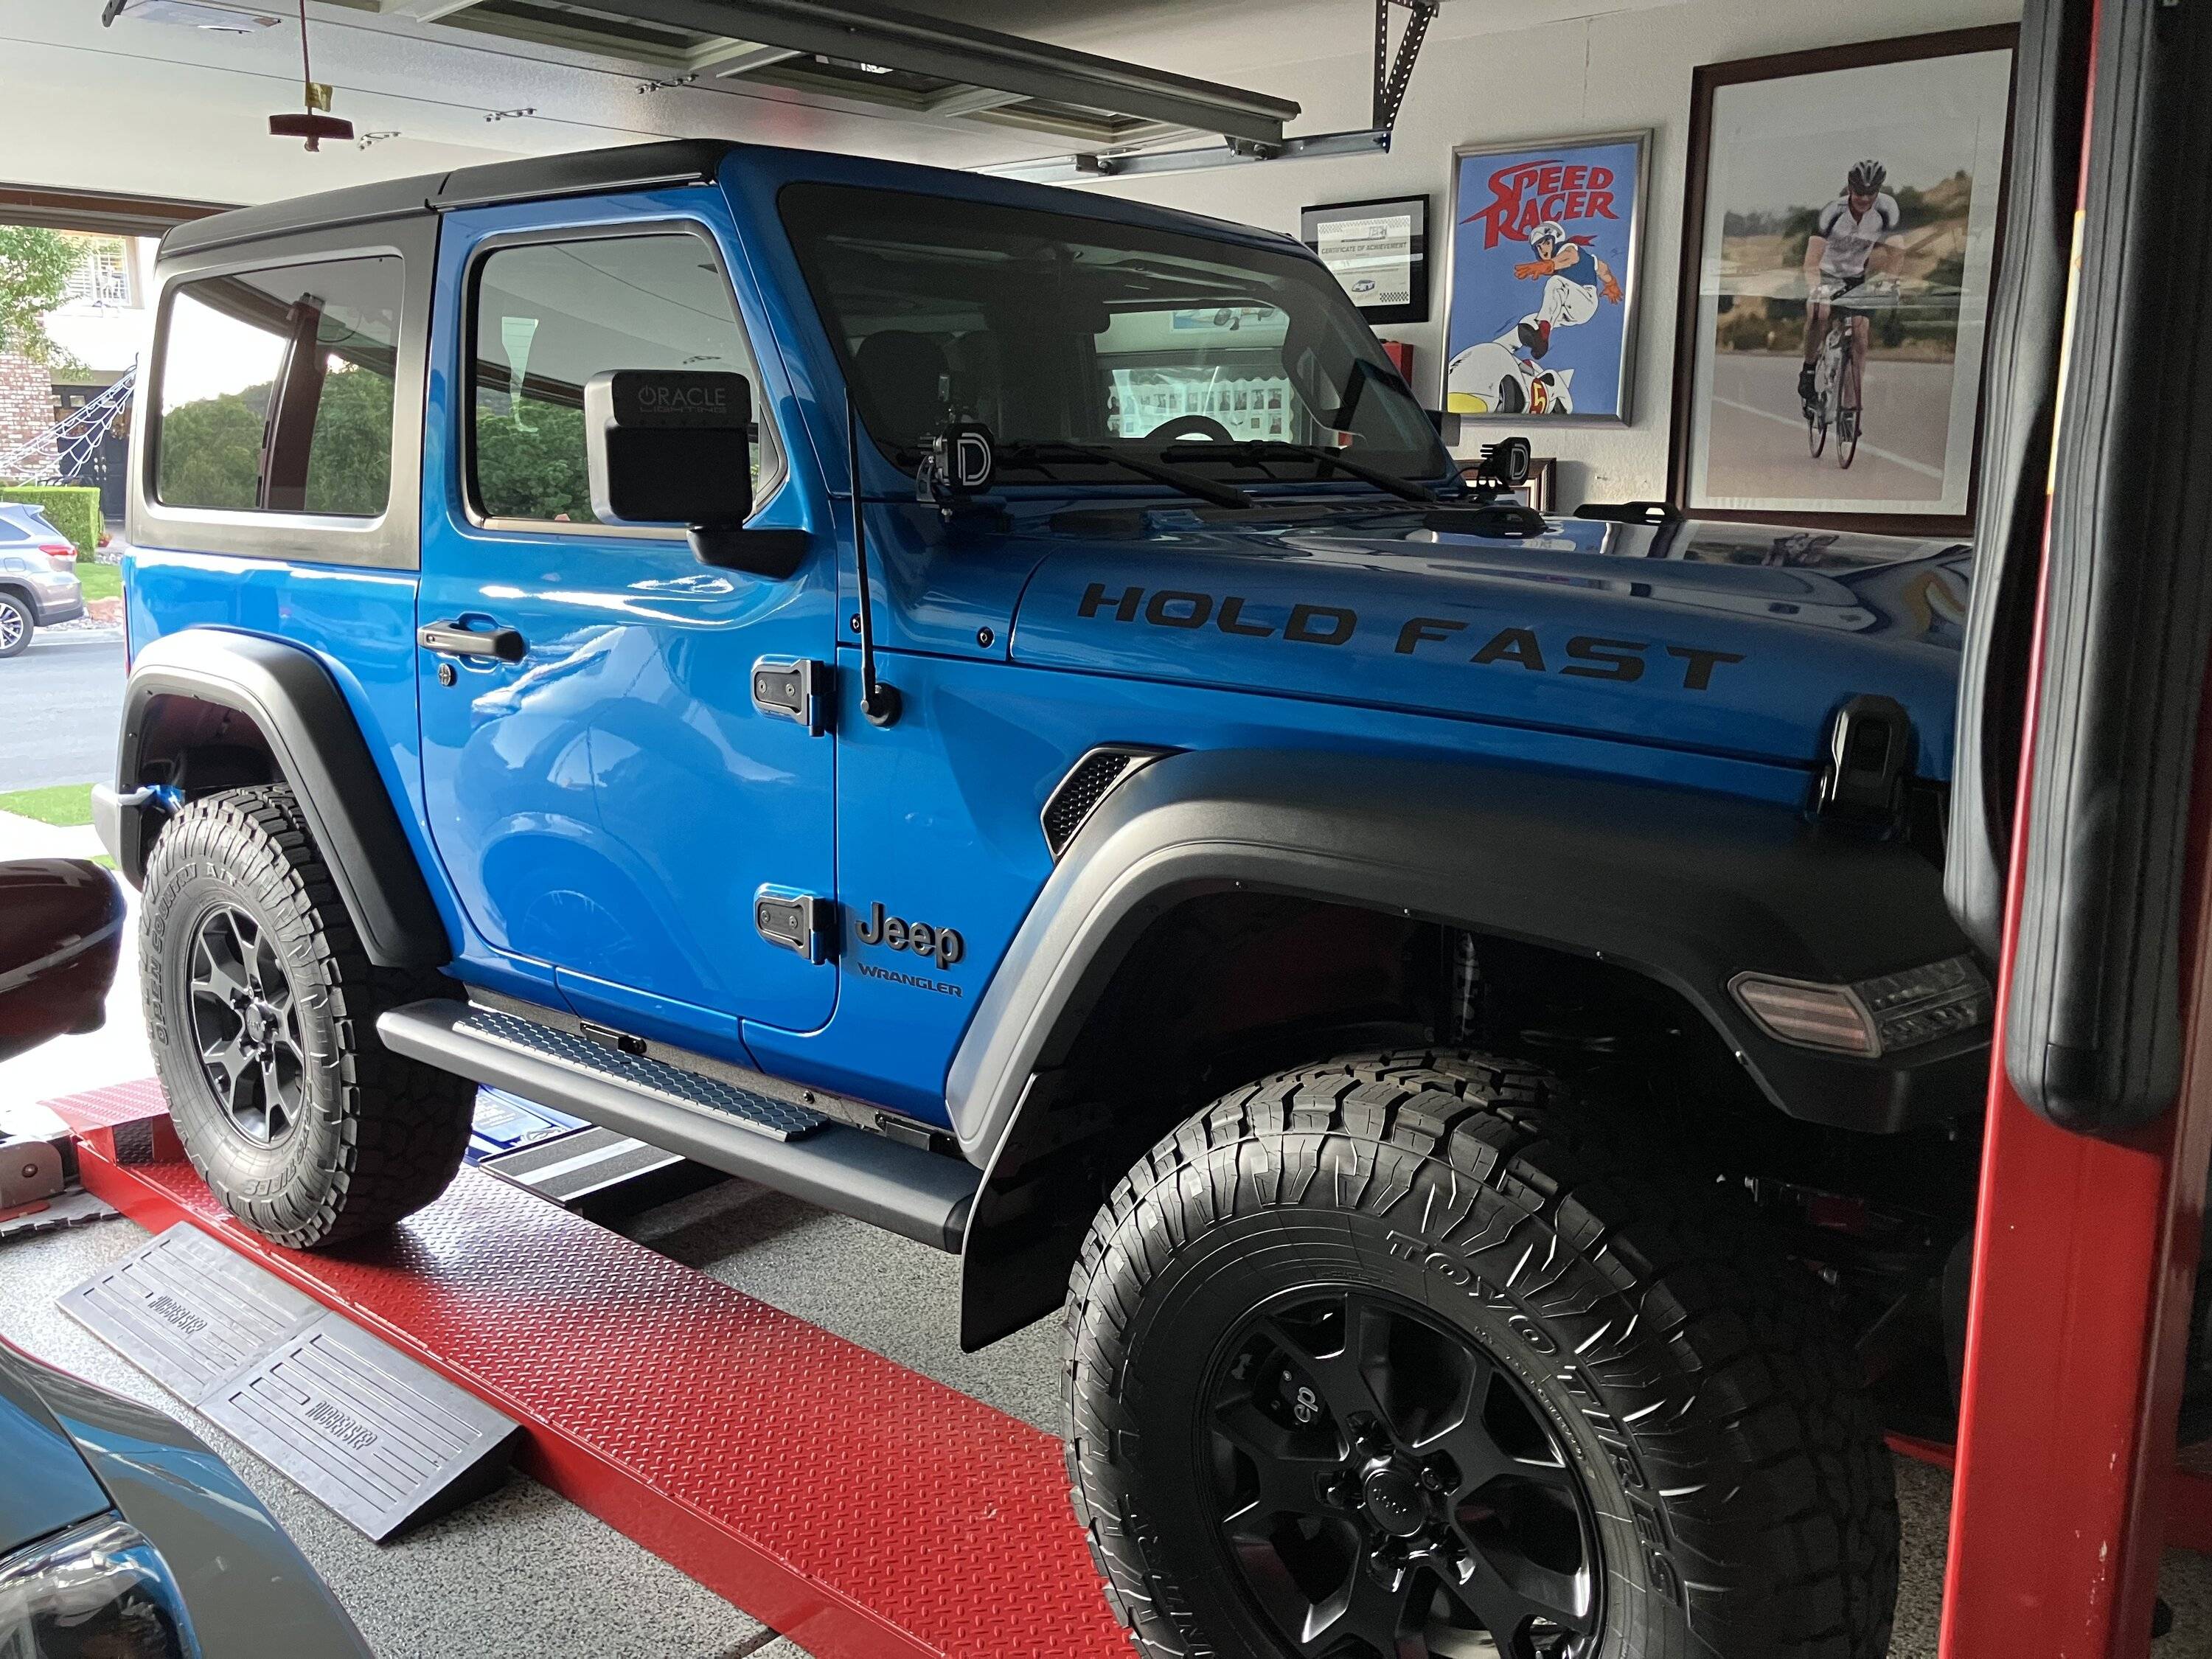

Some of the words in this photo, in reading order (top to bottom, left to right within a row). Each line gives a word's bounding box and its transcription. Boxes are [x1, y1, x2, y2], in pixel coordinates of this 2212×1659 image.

[1488, 159, 1614, 203] SPEED
[1482, 191, 1620, 249] RACER
[1321, 246, 1356, 254] CERTIFICATE
[1366, 241, 1407, 251] ACHIEVEMENT
[638, 385, 726, 406] ORACLE
[1533, 382, 1546, 413] 5
[1077, 582, 1358, 646] HOLD
[1394, 617, 1748, 690] FAST
[855, 901, 964, 970] Jeep
[858, 961, 963, 998] WRANGLER
[1385, 1229, 1557, 1355] TOYO
[1557, 1364, 1682, 1609] TIRES
